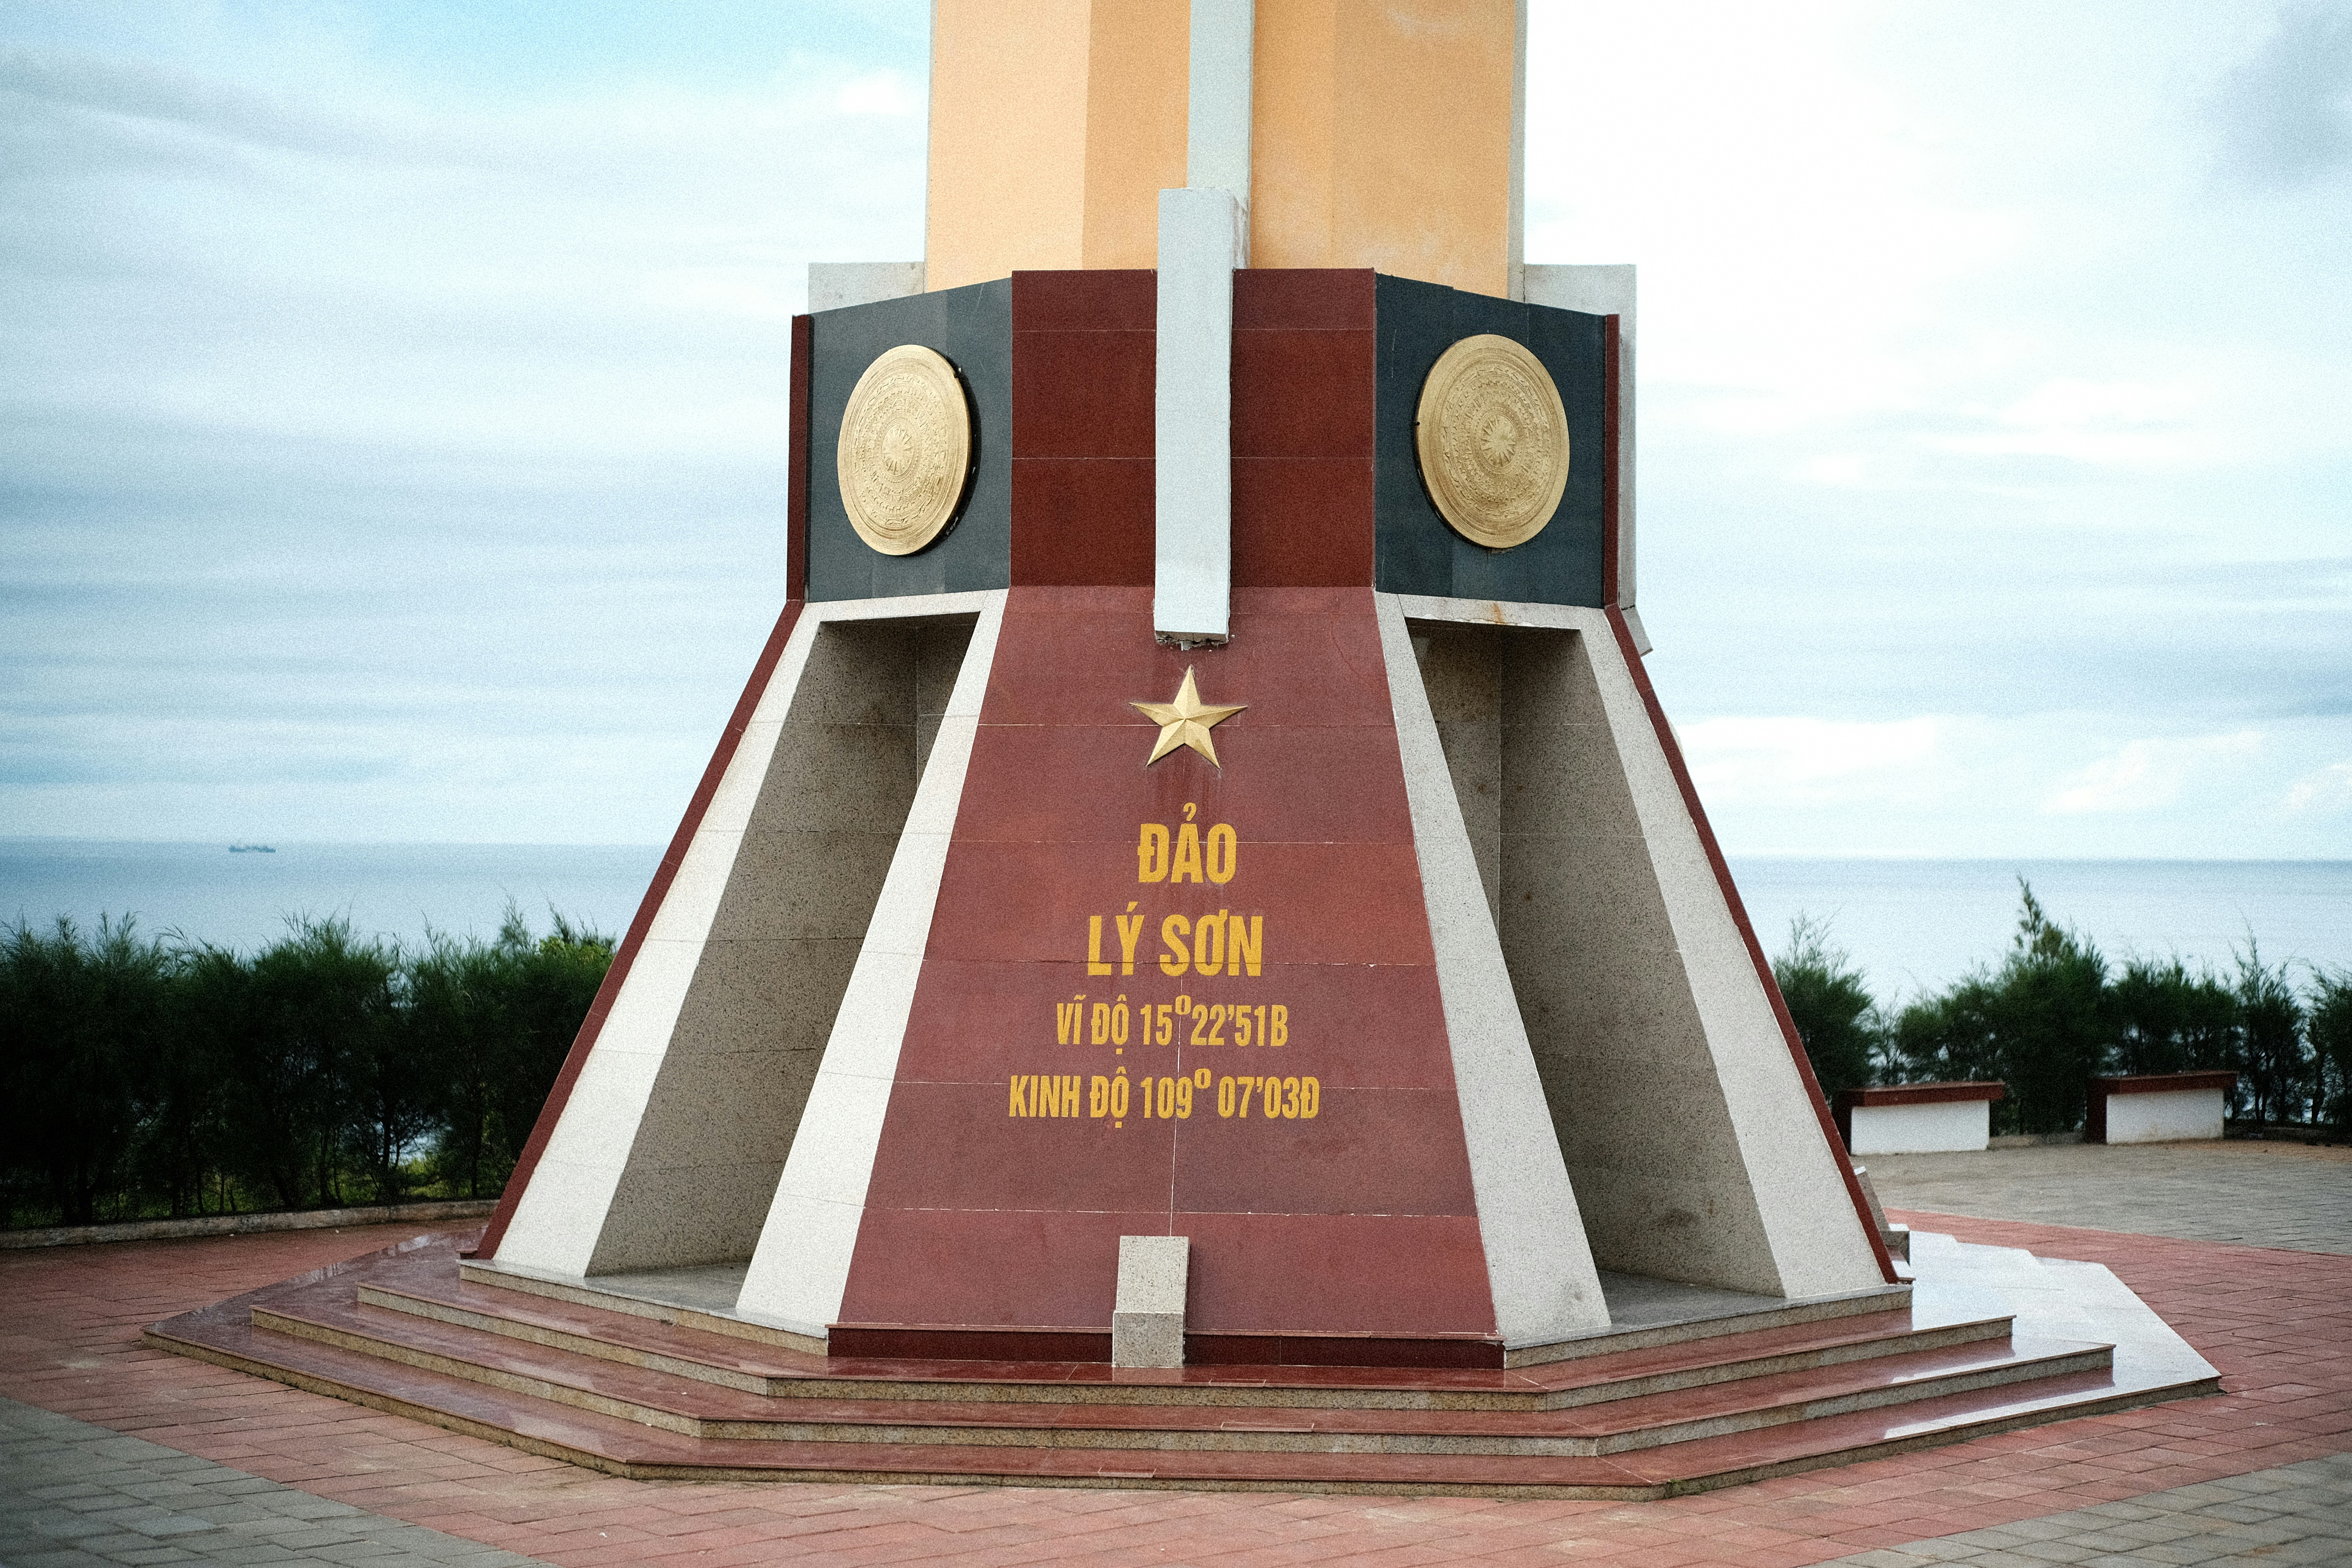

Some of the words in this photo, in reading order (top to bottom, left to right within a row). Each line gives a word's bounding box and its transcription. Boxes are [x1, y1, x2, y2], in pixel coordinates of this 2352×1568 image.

[1138, 802, 1237, 884] ĐẢO
[1088, 902, 1145, 976] LÝ
[1160, 909, 1263, 977] SƠN
[1057, 994, 1086, 1045] VĨ
[1091, 994, 1129, 1055] ĐỘ
[1009, 1075, 1081, 1118] KINH
[1089, 1066, 1130, 1128] ĐỘ
